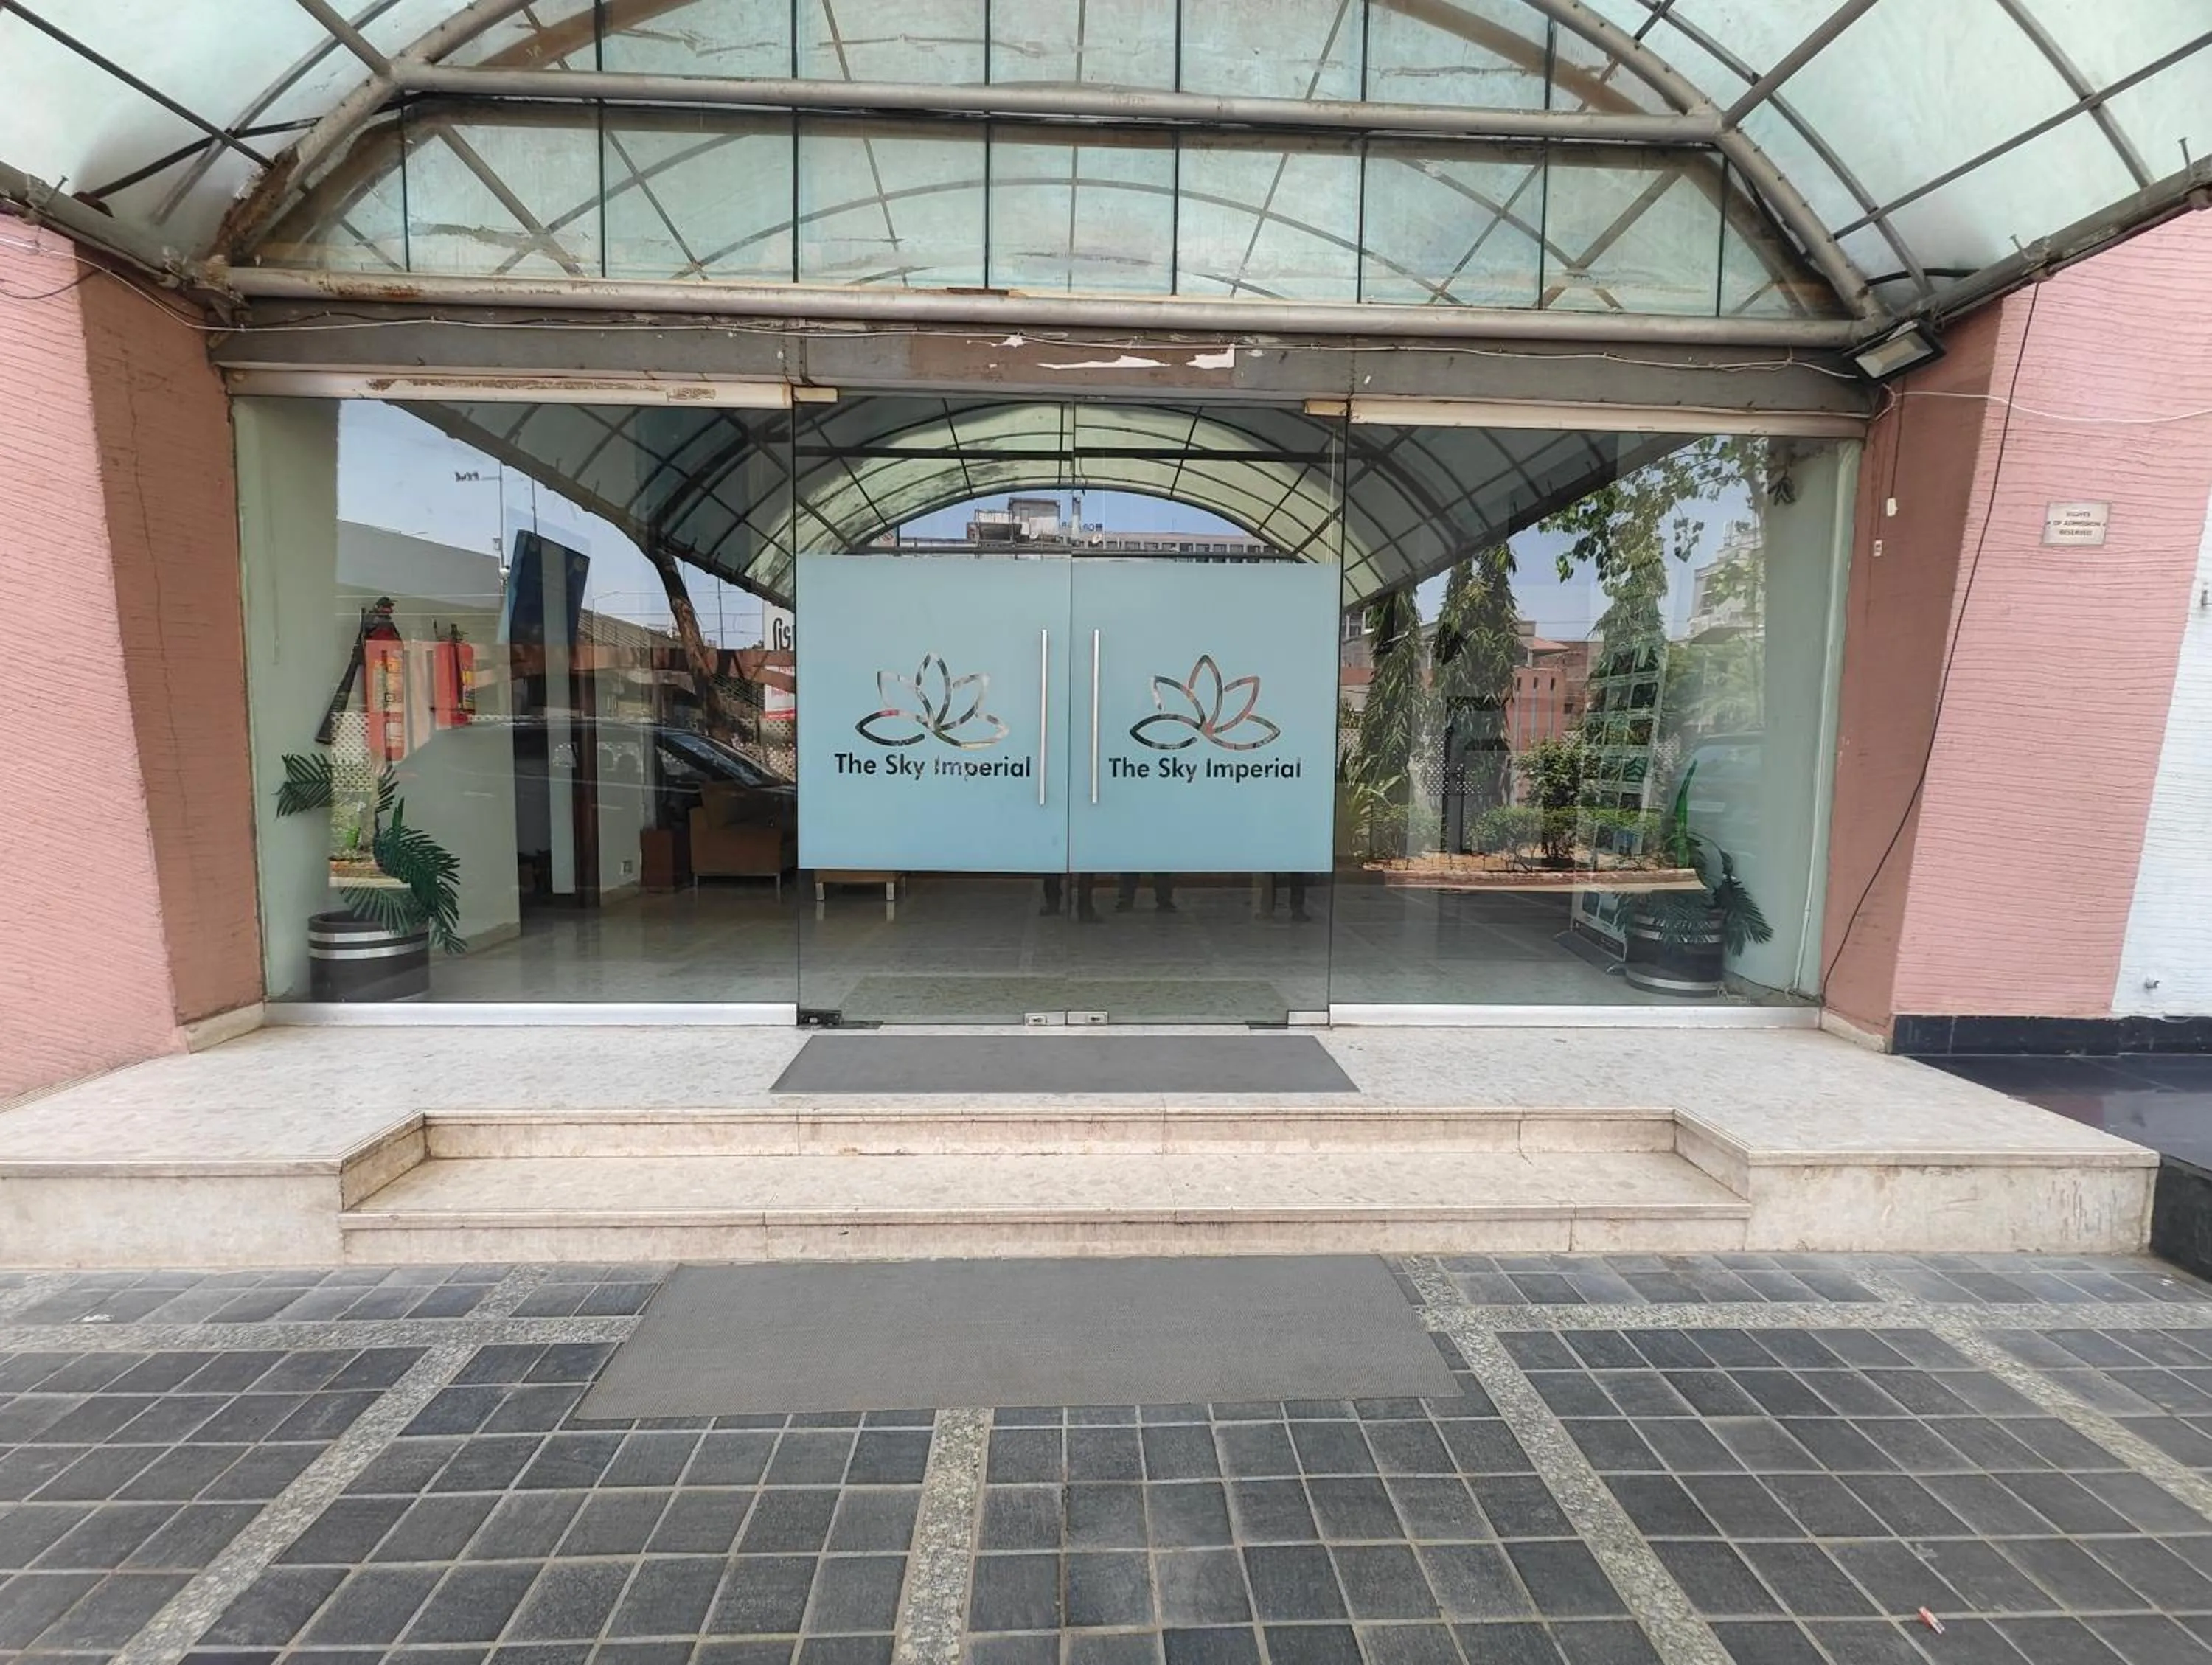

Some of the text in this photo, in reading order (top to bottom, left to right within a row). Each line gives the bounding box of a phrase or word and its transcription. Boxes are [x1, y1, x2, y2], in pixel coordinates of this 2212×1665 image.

[835, 752, 1032, 782] The Sky Imperial
[1108, 757, 1301, 783] The Sky Imperial
